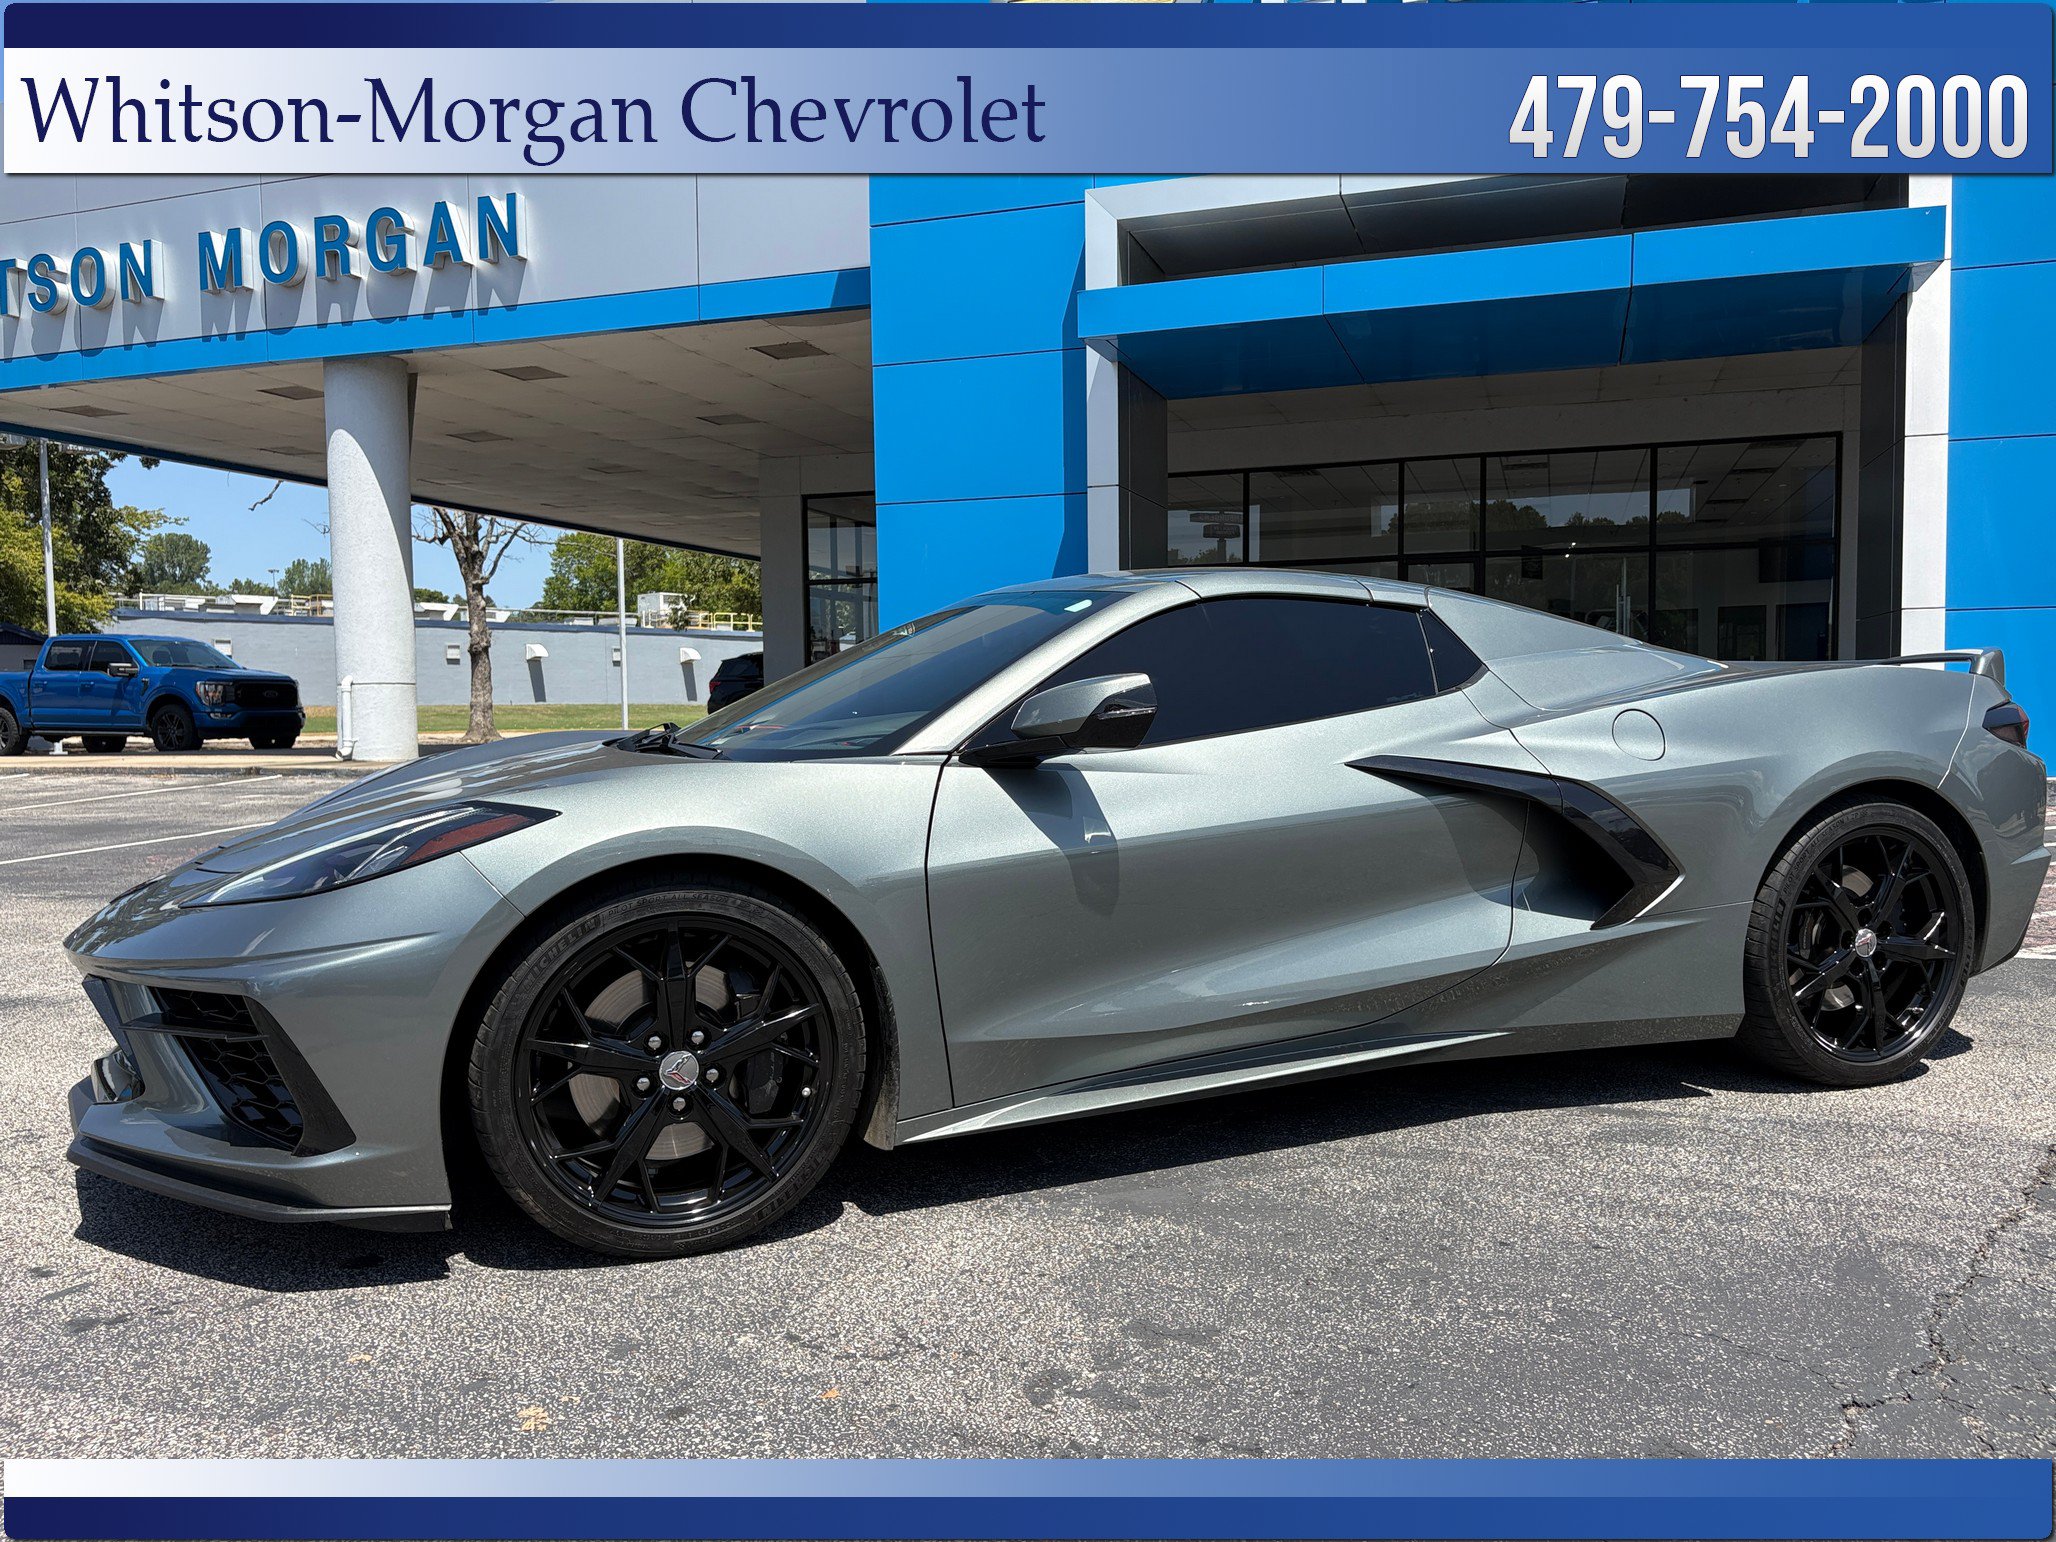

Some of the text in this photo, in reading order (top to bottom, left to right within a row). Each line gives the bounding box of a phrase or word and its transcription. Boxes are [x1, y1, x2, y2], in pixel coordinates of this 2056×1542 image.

[199, 192, 519, 291] MORGAN
[608, 903, 633, 916] PILOT
[636, 895, 666, 906] SPORT
[692, 893, 729, 904] SEASON
[522, 914, 601, 991] MICHELIN
